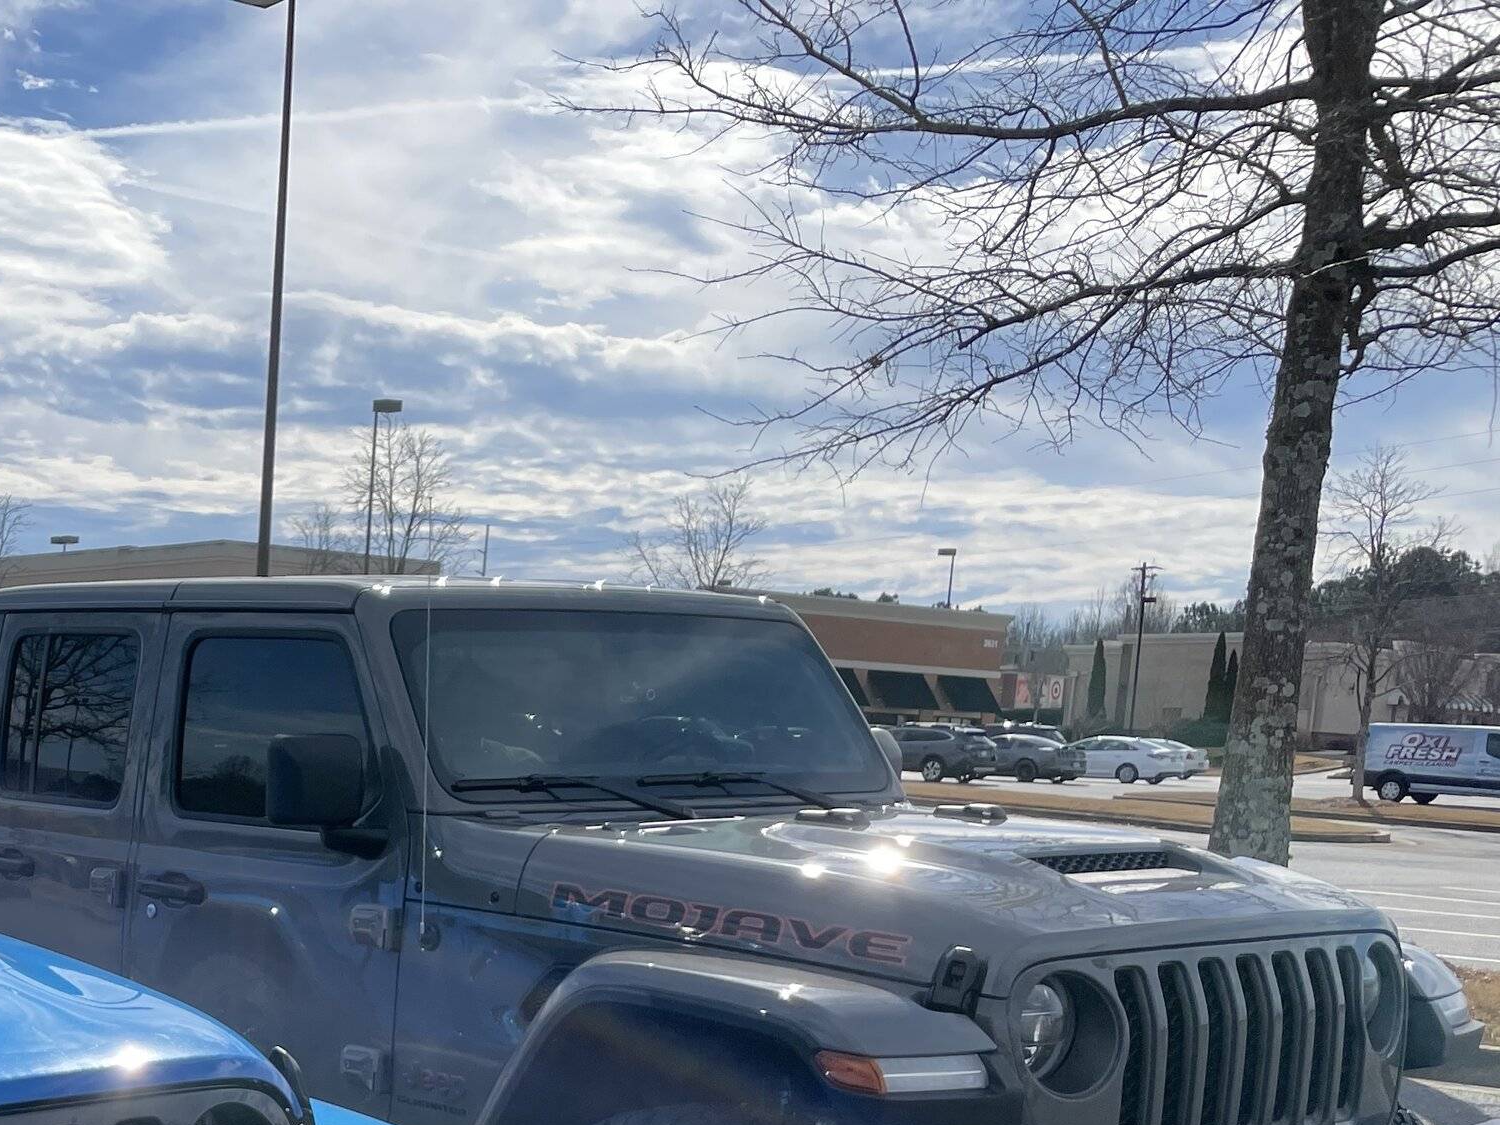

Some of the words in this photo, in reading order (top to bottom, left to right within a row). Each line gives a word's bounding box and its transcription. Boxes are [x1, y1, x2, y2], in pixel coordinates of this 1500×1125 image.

[1402, 733, 1449, 748] OXI
[1387, 745, 1461, 760] FRESH
[551, 881, 913, 968] MOJAVE
